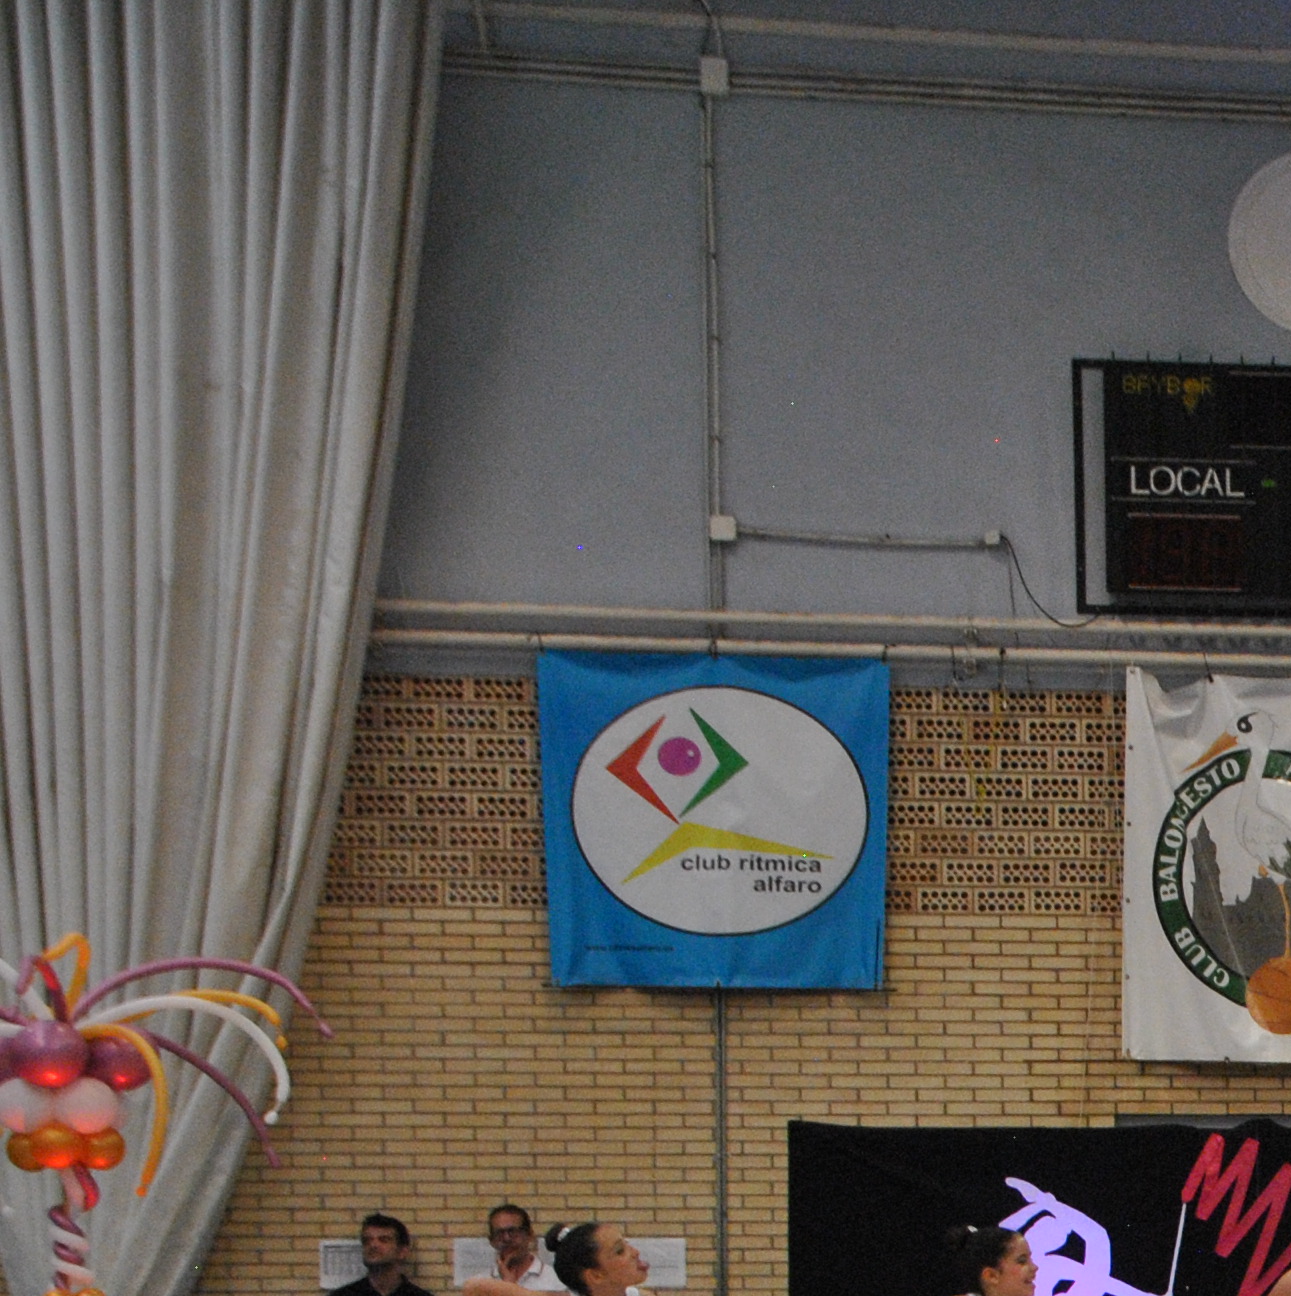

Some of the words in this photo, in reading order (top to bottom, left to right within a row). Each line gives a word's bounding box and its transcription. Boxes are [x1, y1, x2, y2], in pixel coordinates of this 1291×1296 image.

[1129, 464, 1246, 499] LOCAL
[680, 854, 731, 873] club
[738, 854, 822, 874] ritmica
[753, 874, 822, 894] alfaro
[1174, 926, 1231, 988] CLUB
